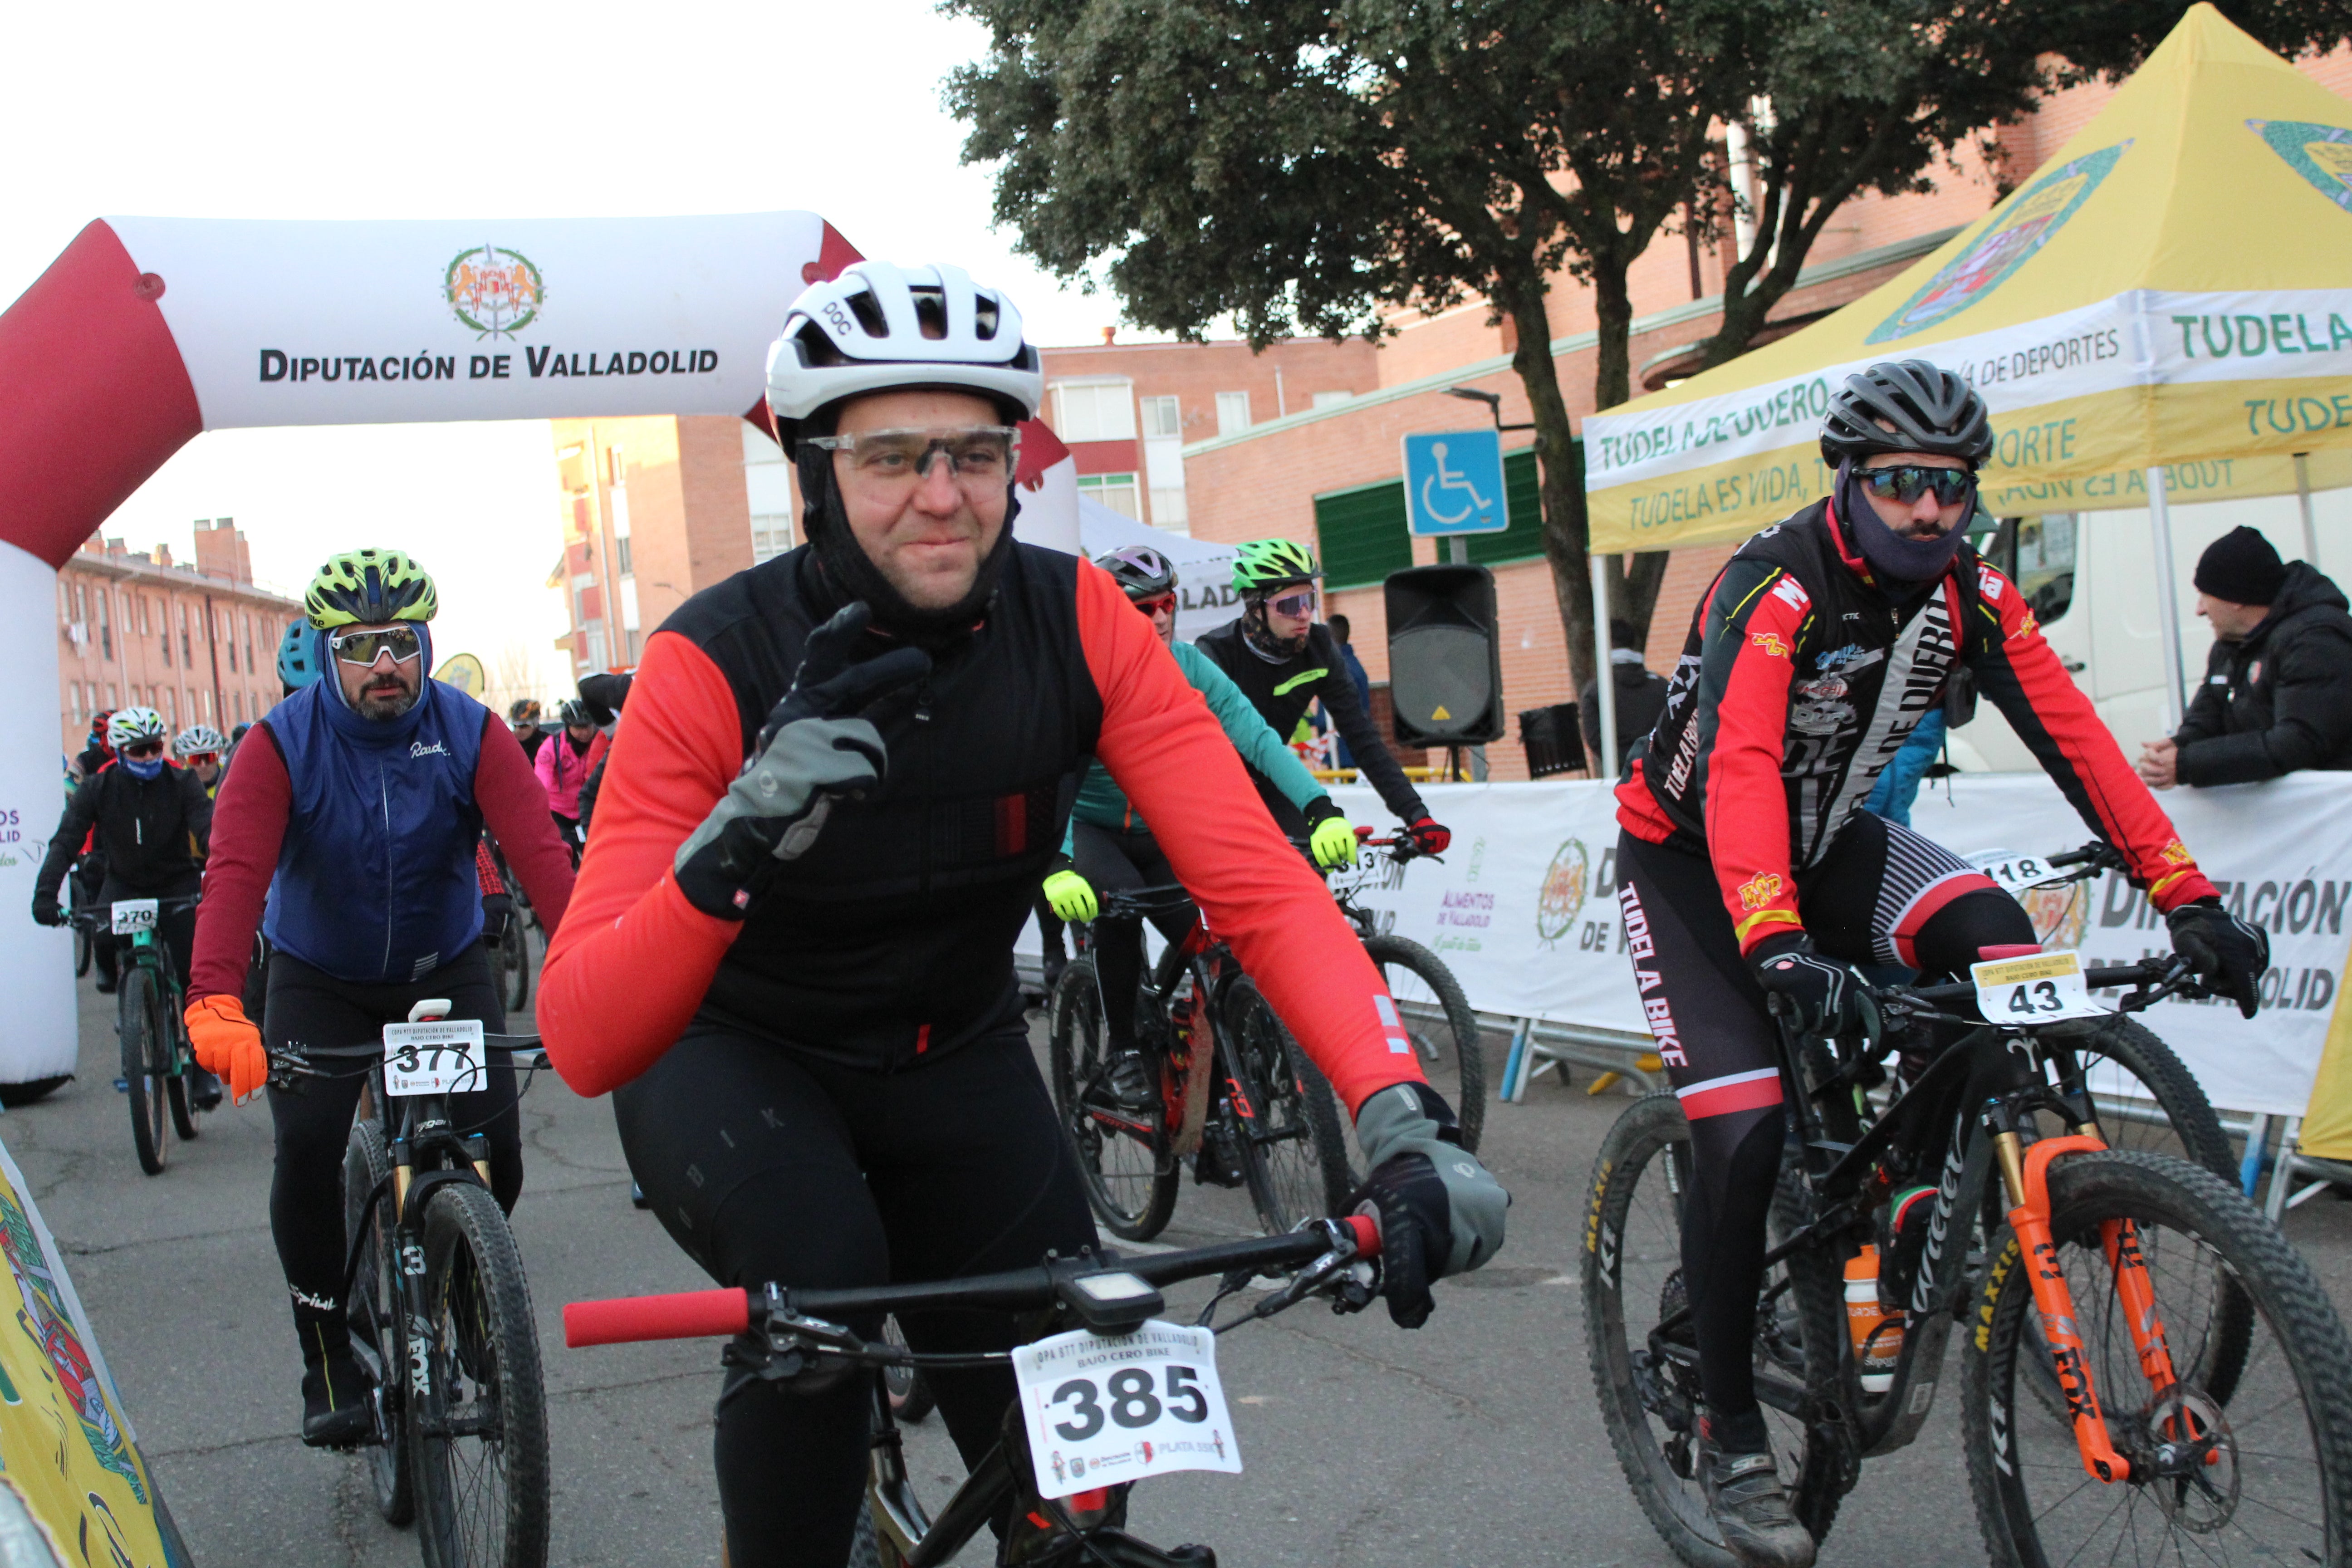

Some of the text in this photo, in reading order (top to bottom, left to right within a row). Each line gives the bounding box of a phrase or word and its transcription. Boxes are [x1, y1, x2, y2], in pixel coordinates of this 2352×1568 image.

[822, 301, 853, 337] POC
[2171, 313, 2352, 358] TUDELA
[260, 346, 718, 382] DIPUTACIÓN DE VALLADOLID
[1980, 356, 2007, 385] DE
[2013, 328, 2119, 380] DEPORTES
[1631, 483, 1713, 530] TUDELA
[1716, 475, 1741, 513] ES
[1749, 462, 1808, 507] VIDA,
[1579, 921, 1609, 951] DE
[1619, 881, 1689, 1067] TUDELA BIKE
[2008, 980, 2063, 1014] 43
[396, 1042, 471, 1073] 377
[1586, 1158, 1612, 1254] MAXXIS
[1974, 1238, 2020, 1353] MAXXIS
[408, 1337, 431, 1399] FOX
[1077, 1347, 1171, 1369] BAJO CERO BIKE
[2053, 1347, 2097, 1425] FOX
[1052, 1365, 1209, 1442] 385
